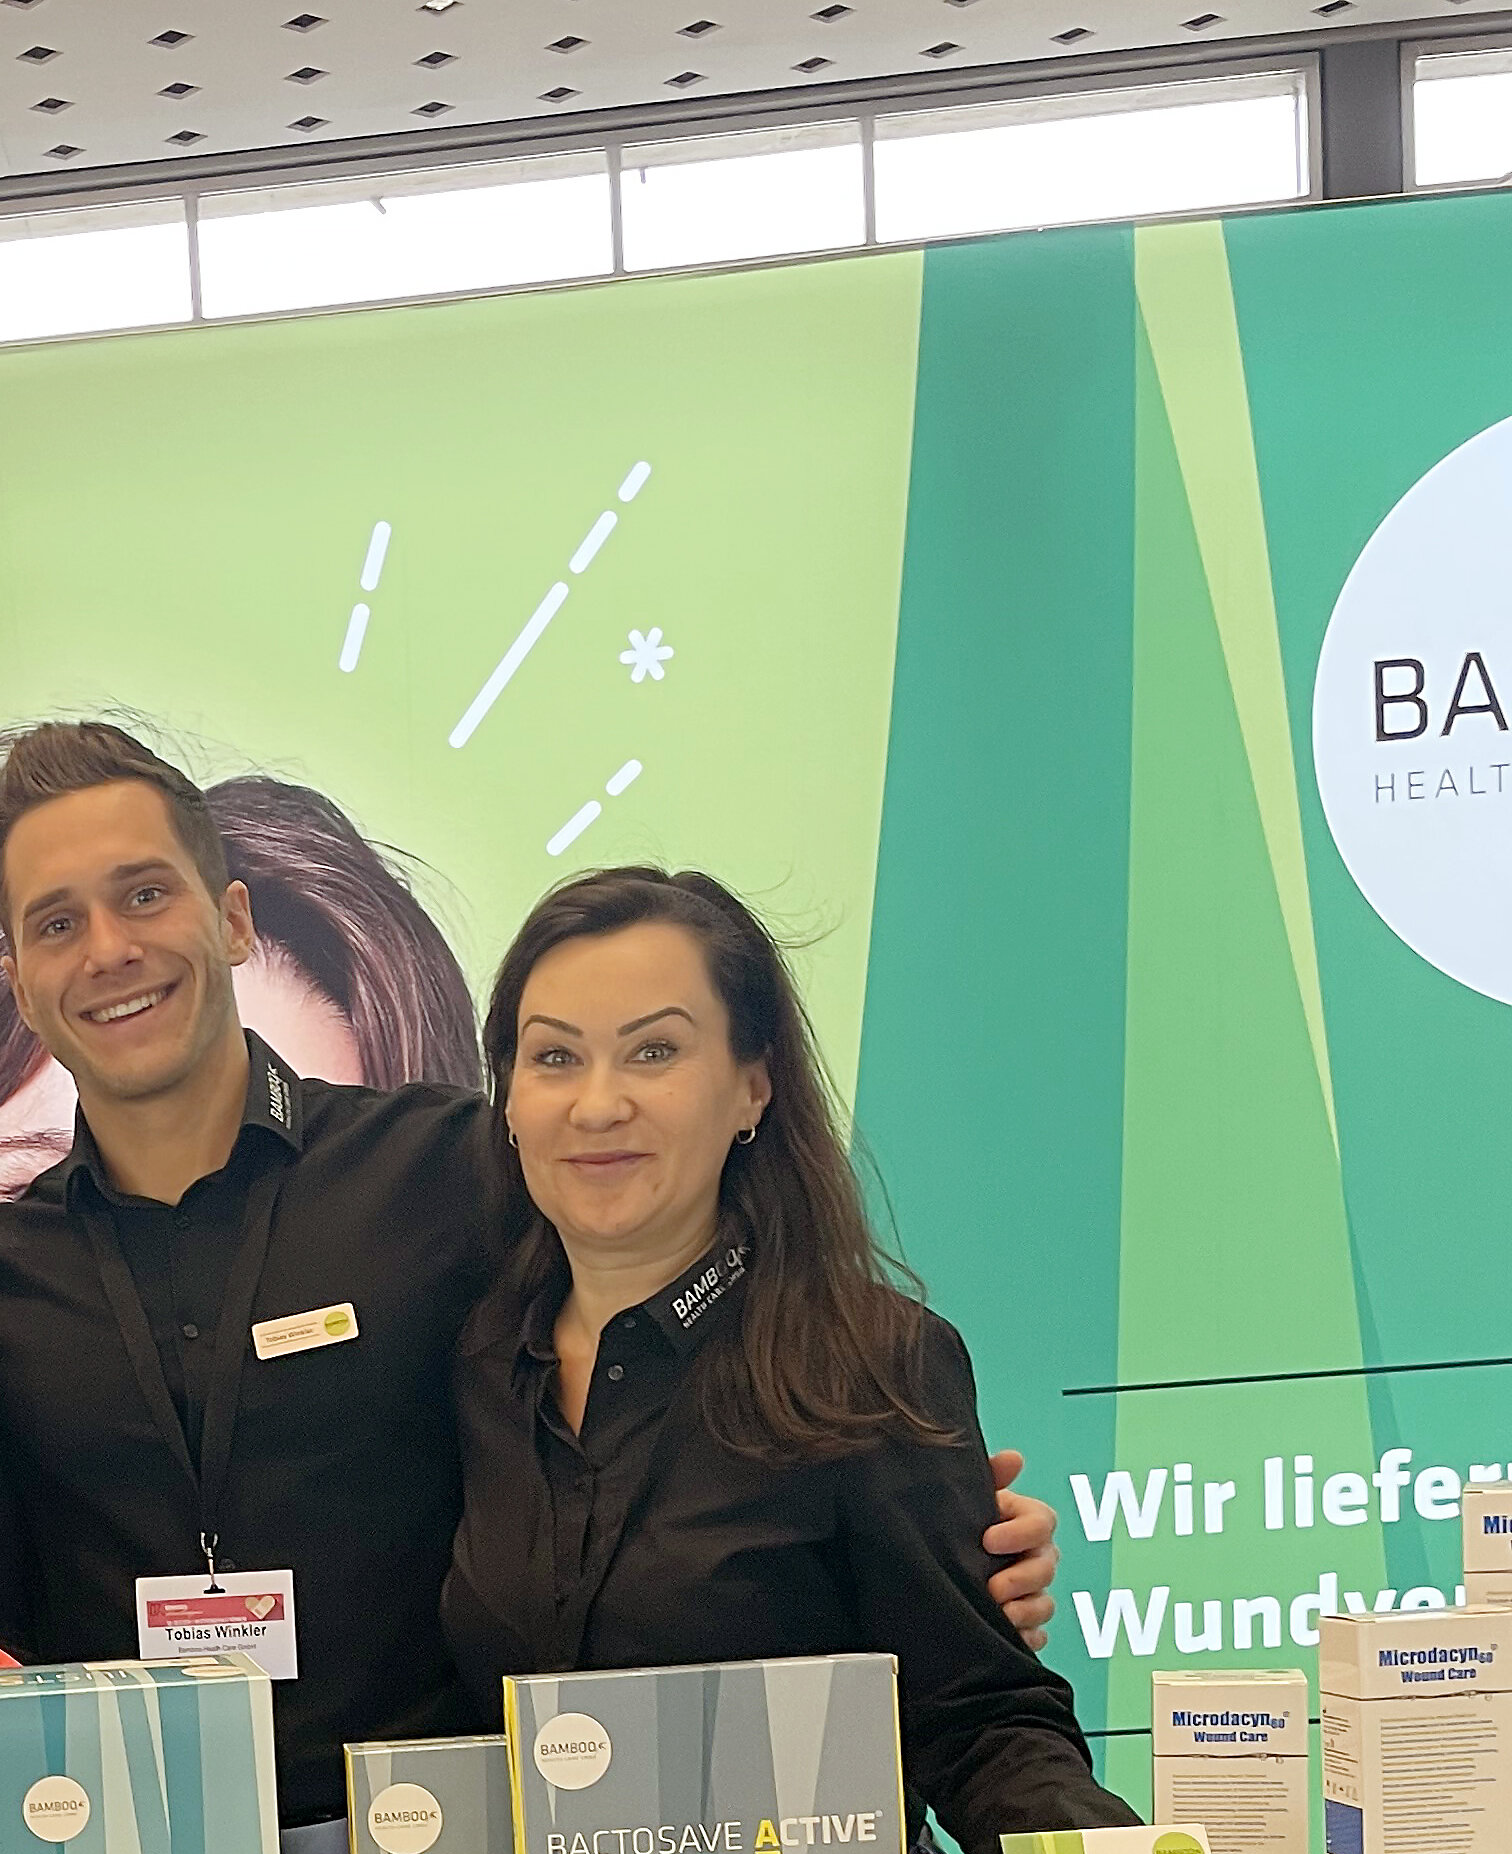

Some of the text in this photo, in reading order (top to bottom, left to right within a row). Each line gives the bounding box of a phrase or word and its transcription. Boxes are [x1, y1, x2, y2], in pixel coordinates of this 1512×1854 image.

[1069, 1447, 1512, 1543] Wir liefe
[165, 1624, 267, 1641] Tobias Winkler
[1401, 1667, 1477, 1684] Wound Care
[1193, 1731, 1268, 1743] Wound Care
[540, 1741, 597, 1756] BAMBOO
[29, 1800, 78, 1813] BAMBOO
[374, 1810, 428, 1824] BAMBOO
